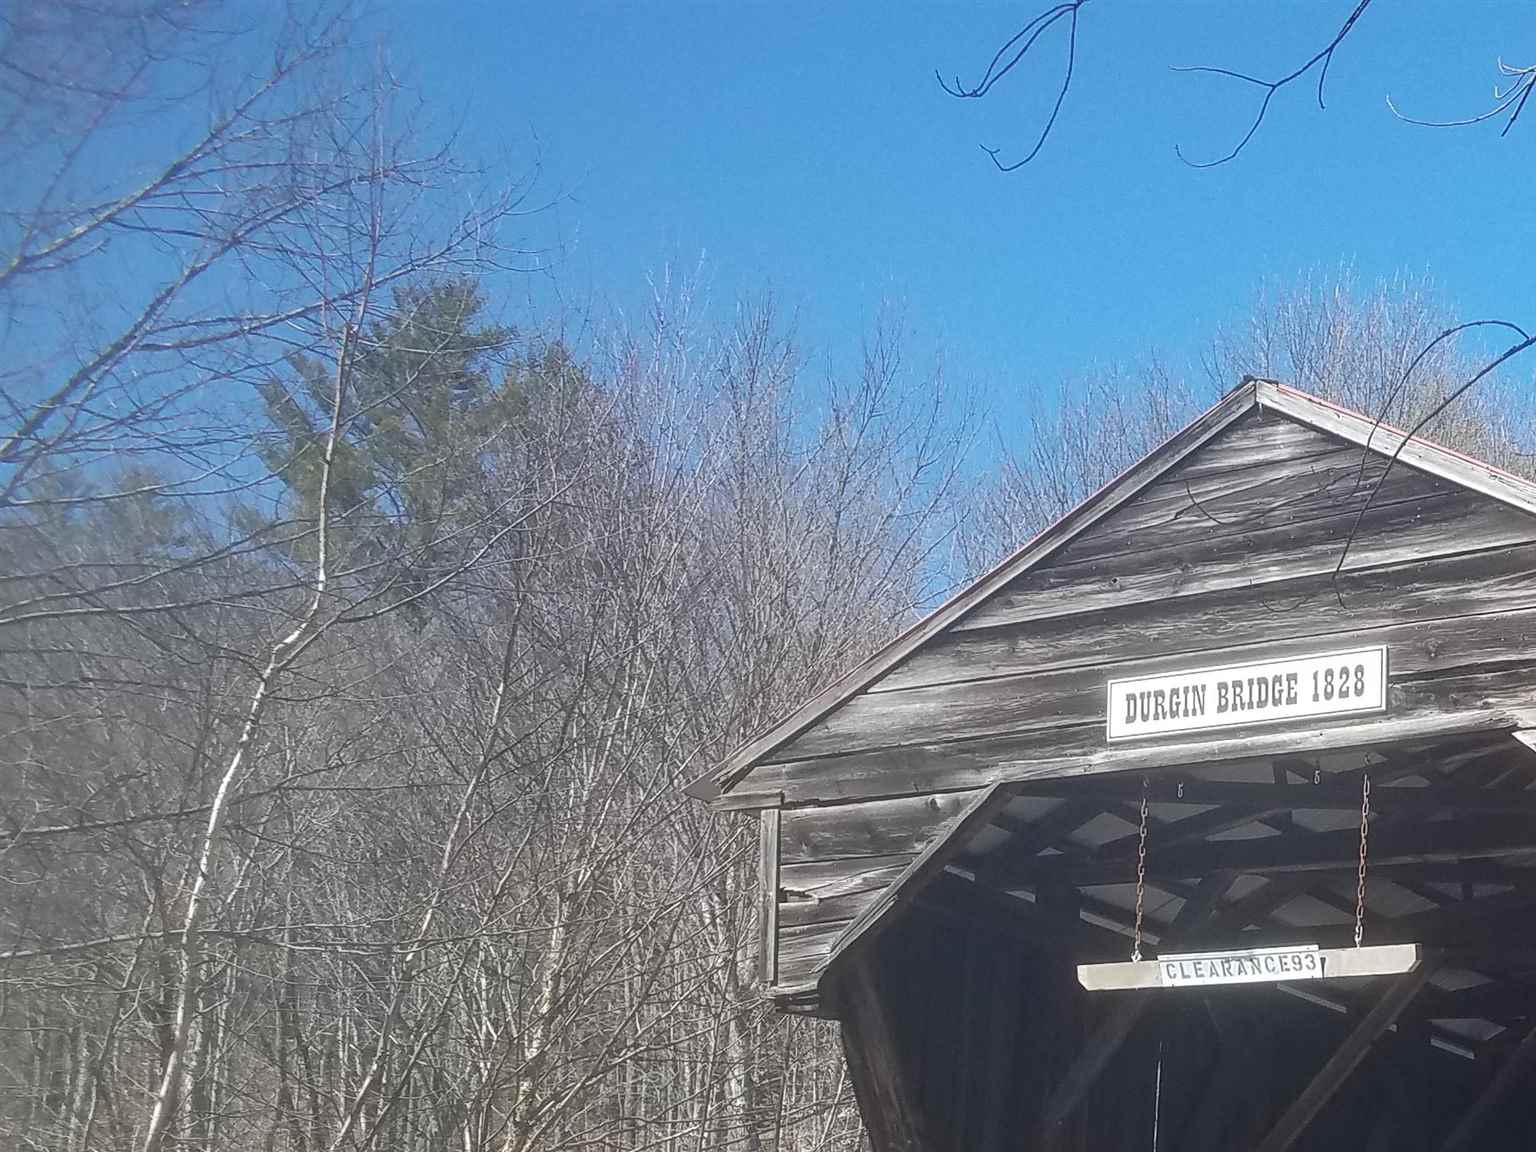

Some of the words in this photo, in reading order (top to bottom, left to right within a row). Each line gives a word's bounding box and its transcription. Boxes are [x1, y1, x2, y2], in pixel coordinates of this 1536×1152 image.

[1125, 683, 1207, 724] DURGIN
[1216, 672, 1298, 713] BRIDGE
[1312, 664, 1365, 702] 1828
